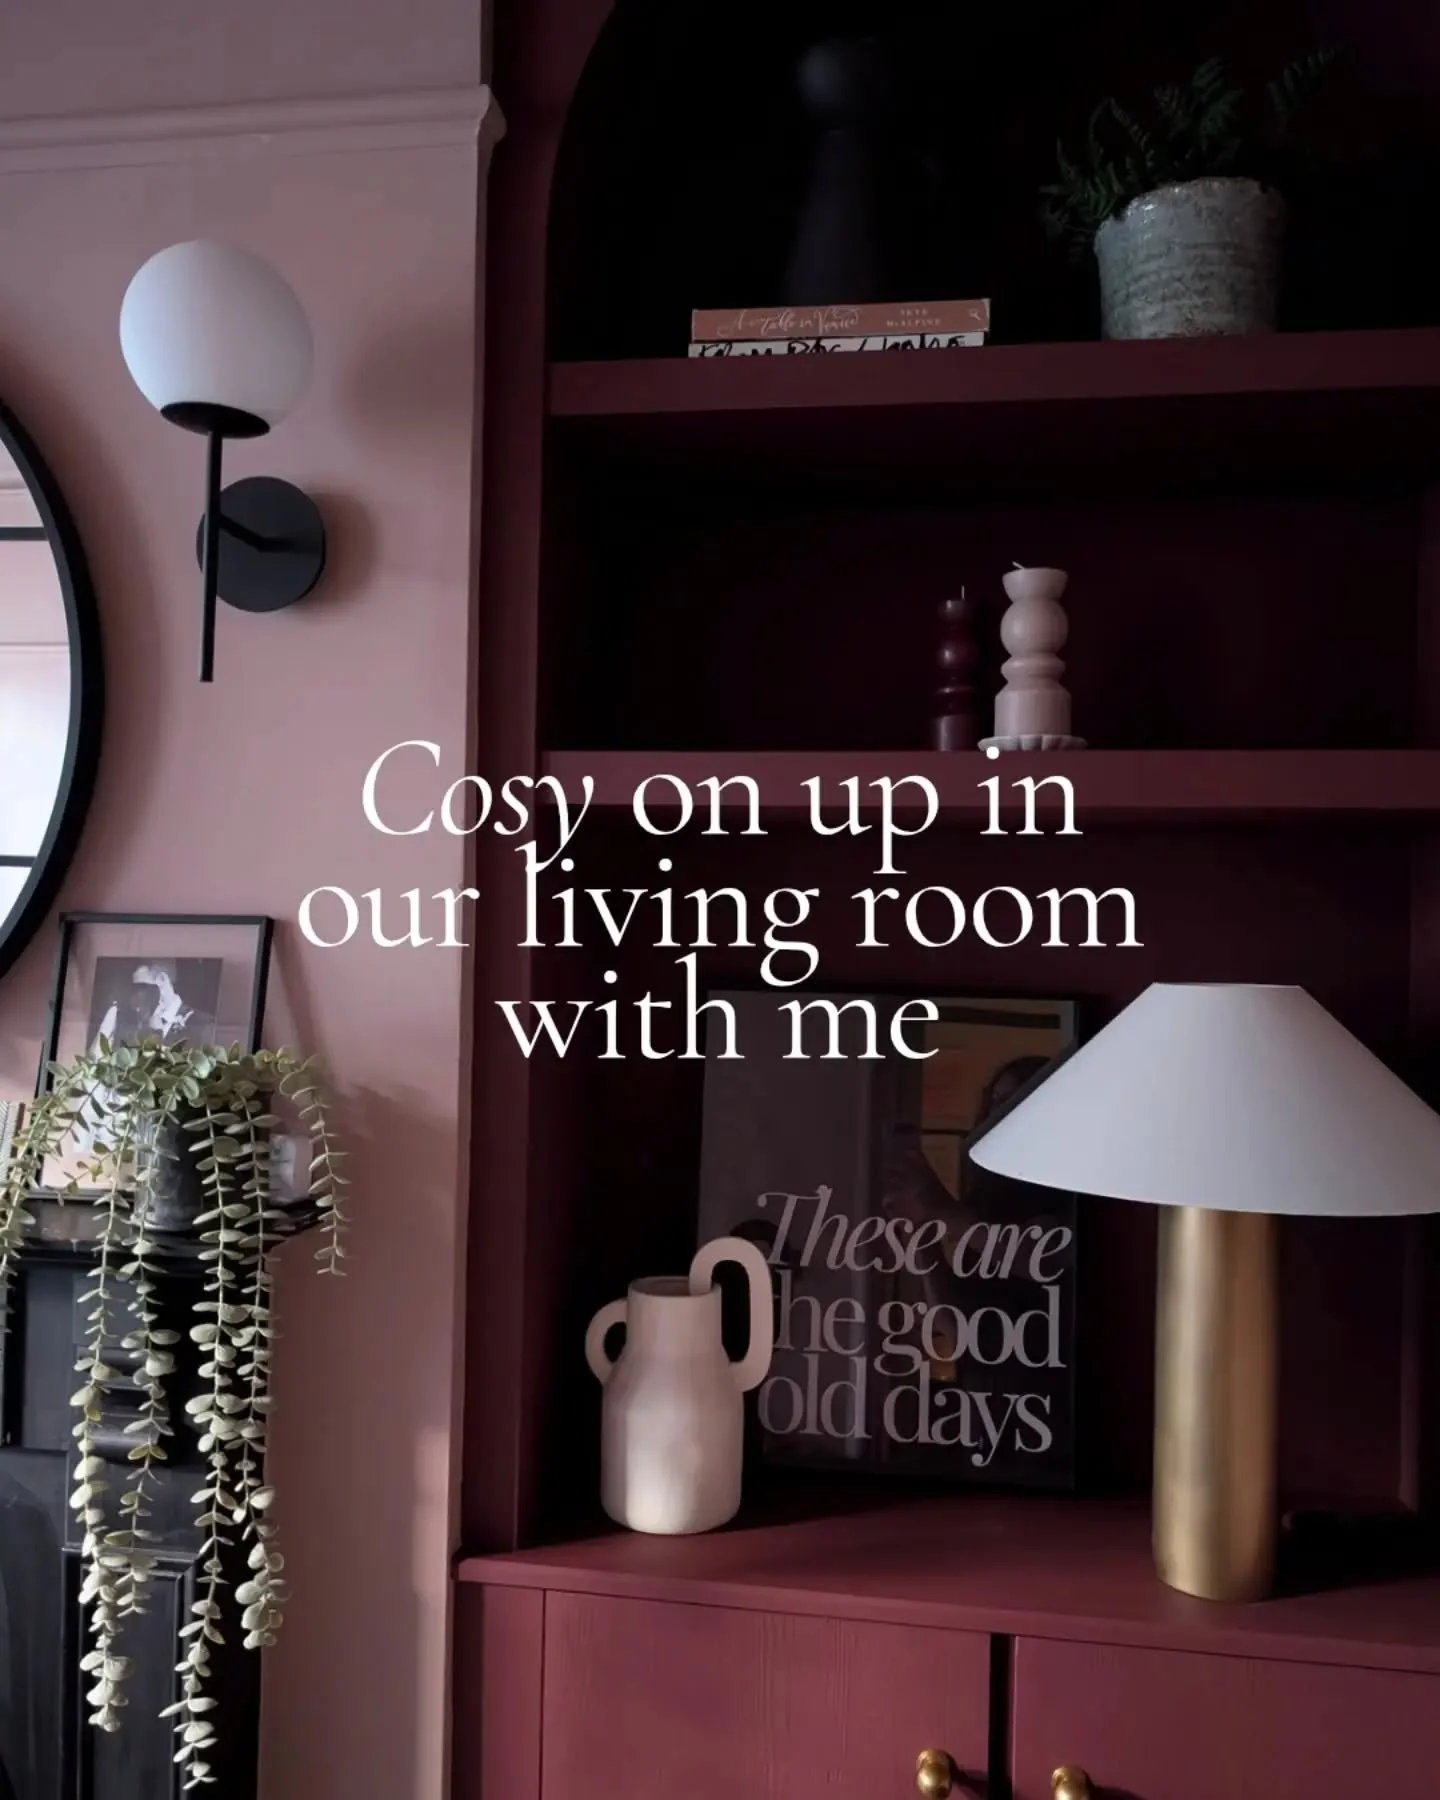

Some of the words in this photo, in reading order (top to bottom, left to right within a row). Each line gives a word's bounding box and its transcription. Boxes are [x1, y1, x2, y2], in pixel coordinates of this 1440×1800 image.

[757, 1184, 949, 1277] These
[952, 1220, 1073, 1283] are
[772, 1268, 867, 1353] he
[873, 1285, 1068, 1378] good
[758, 1353, 873, 1440] old
[882, 1359, 1055, 1469] days
